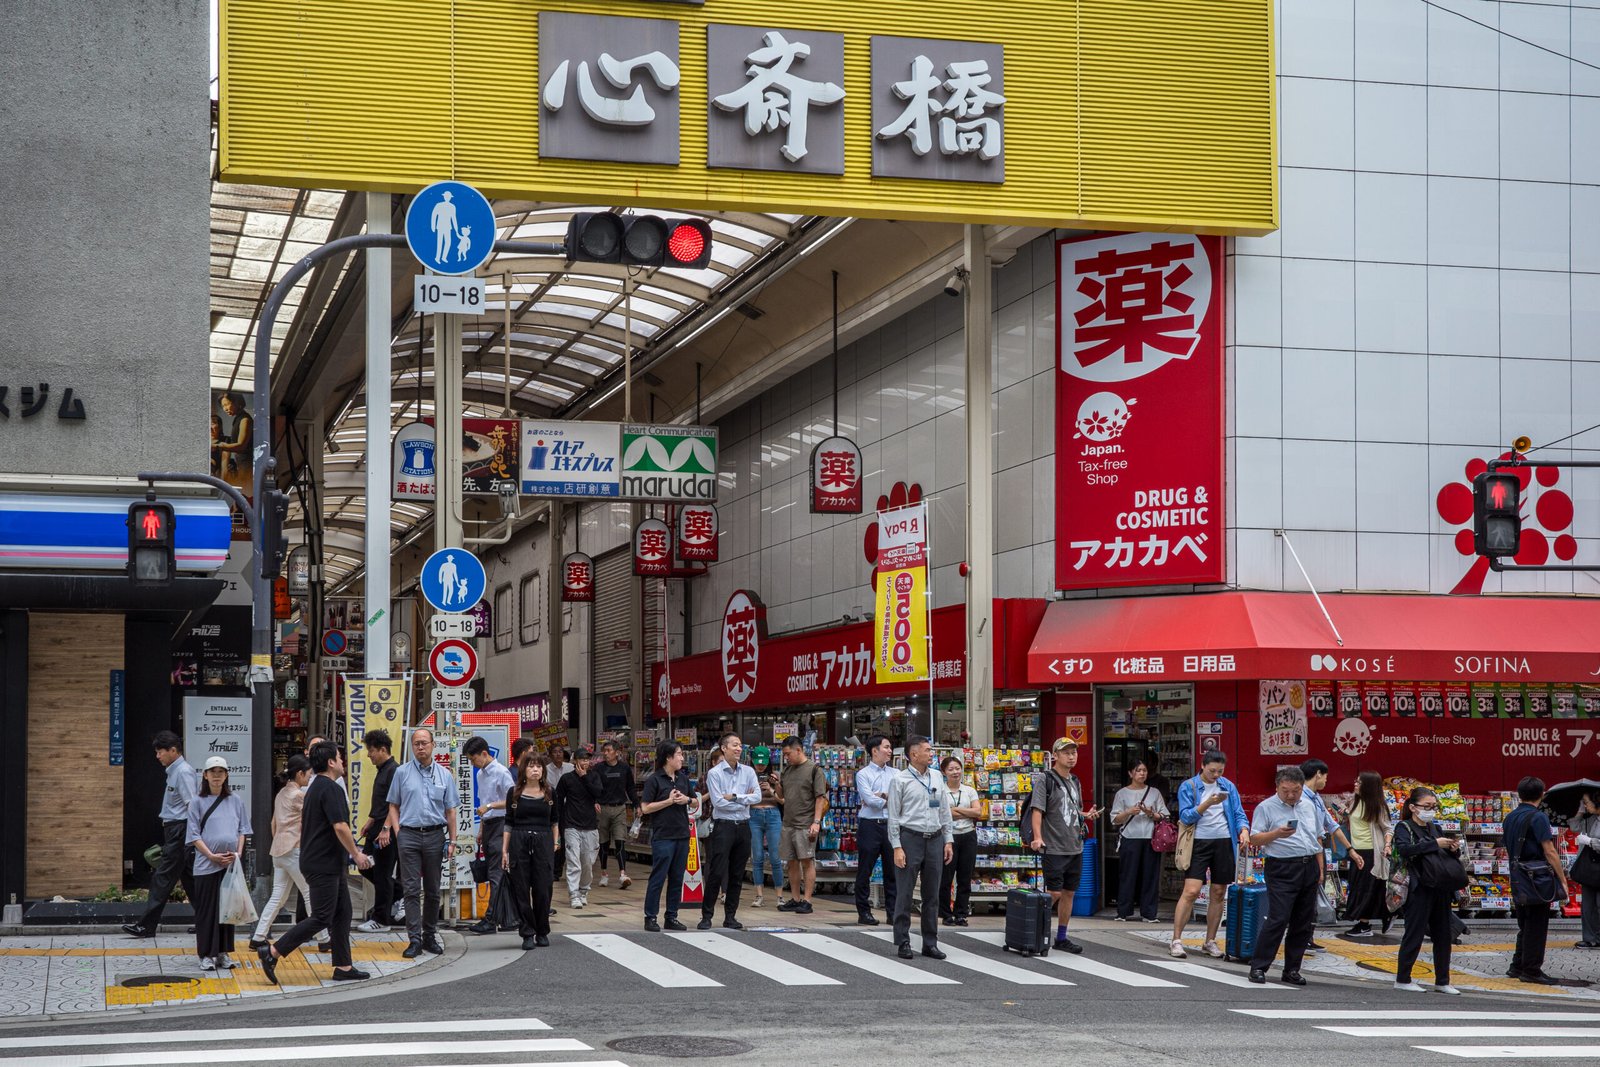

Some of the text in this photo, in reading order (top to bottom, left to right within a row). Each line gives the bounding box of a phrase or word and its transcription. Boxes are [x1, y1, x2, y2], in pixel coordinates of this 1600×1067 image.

[1074, 241, 1197, 368] 薬
[623, 426, 715, 437] Heart Communication
[404, 441, 434, 449] LAWSON
[551, 440, 585, 456] ストア
[1081, 444, 1125, 457] Japan.
[404, 466, 434, 475] STATION
[550, 453, 615, 473] エキスプレス
[820, 451, 856, 488] 薬
[1078, 459, 1127, 472] Tax-free
[1087, 474, 1118, 485] Shop
[530, 483, 611, 495] 株式会社 店研創意
[1135, 486, 1208, 508] DRUG &
[820, 496, 856, 506] アカカベ
[684, 510, 713, 540] 薬
[1116, 507, 1208, 530] COSMETIC
[640, 529, 666, 556] 薬
[684, 547, 713, 555] アカカベ
[1070, 532, 1208, 571] アカカベ
[567, 562, 589, 585] 薬
[640, 563, 667, 571] アカカベ
[726, 606, 757, 696] 薬
[793, 653, 818, 672] DRUG &
[821, 643, 875, 690] アカカ
[1048, 655, 1235, 675] くすり 化粧品 日用品
[1341, 655, 1394, 673] KOSÉ
[1454, 656, 1531, 674] SOFINA
[787, 673, 818, 692] COSMETIC
[1267, 685, 1286, 704] パン
[1264, 708, 1296, 730] おにぎり
[1269, 732, 1290, 747] あります
[1378, 733, 1476, 746] Japan. Tax-free Shop
[1513, 728, 1560, 741] DRUG &
[1567, 729, 1600, 758] ア
[1502, 743, 1560, 757] COSMETIC
